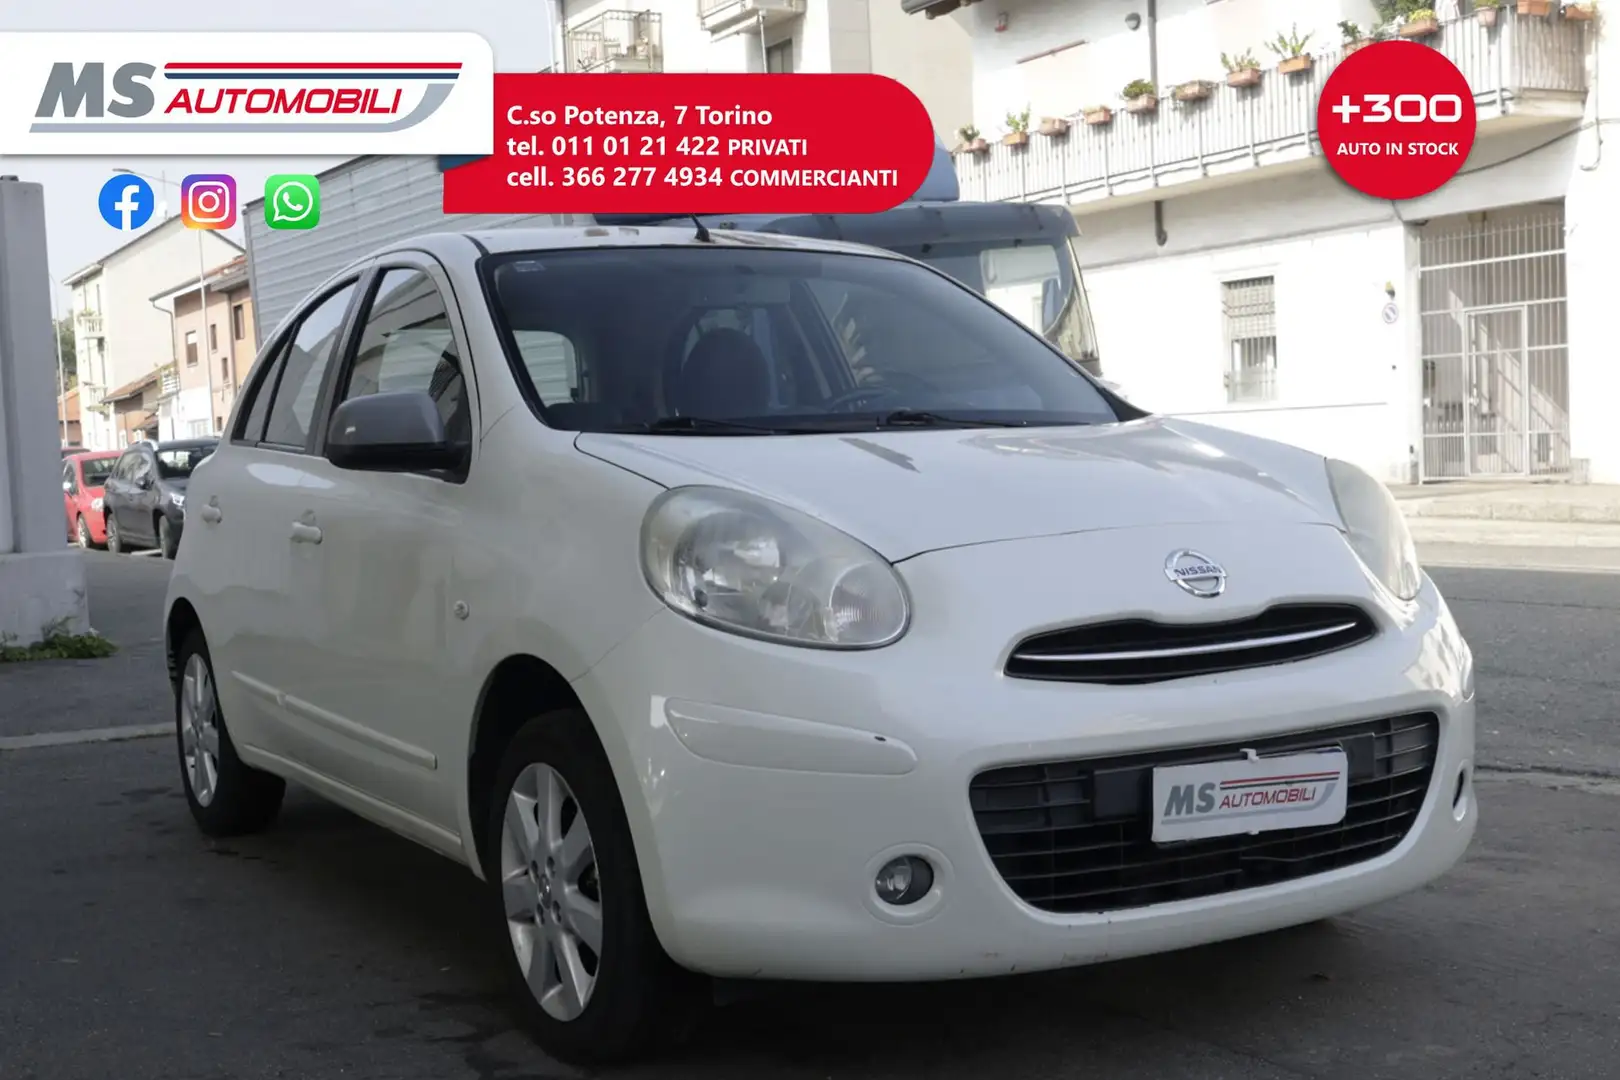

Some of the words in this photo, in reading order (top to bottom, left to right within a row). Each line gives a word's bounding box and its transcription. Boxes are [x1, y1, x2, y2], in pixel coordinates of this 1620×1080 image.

[1173, 565, 1222, 577] NISSAN
[1164, 782, 1216, 817] MS
[1219, 787, 1316, 809] AUTOMOBILI
